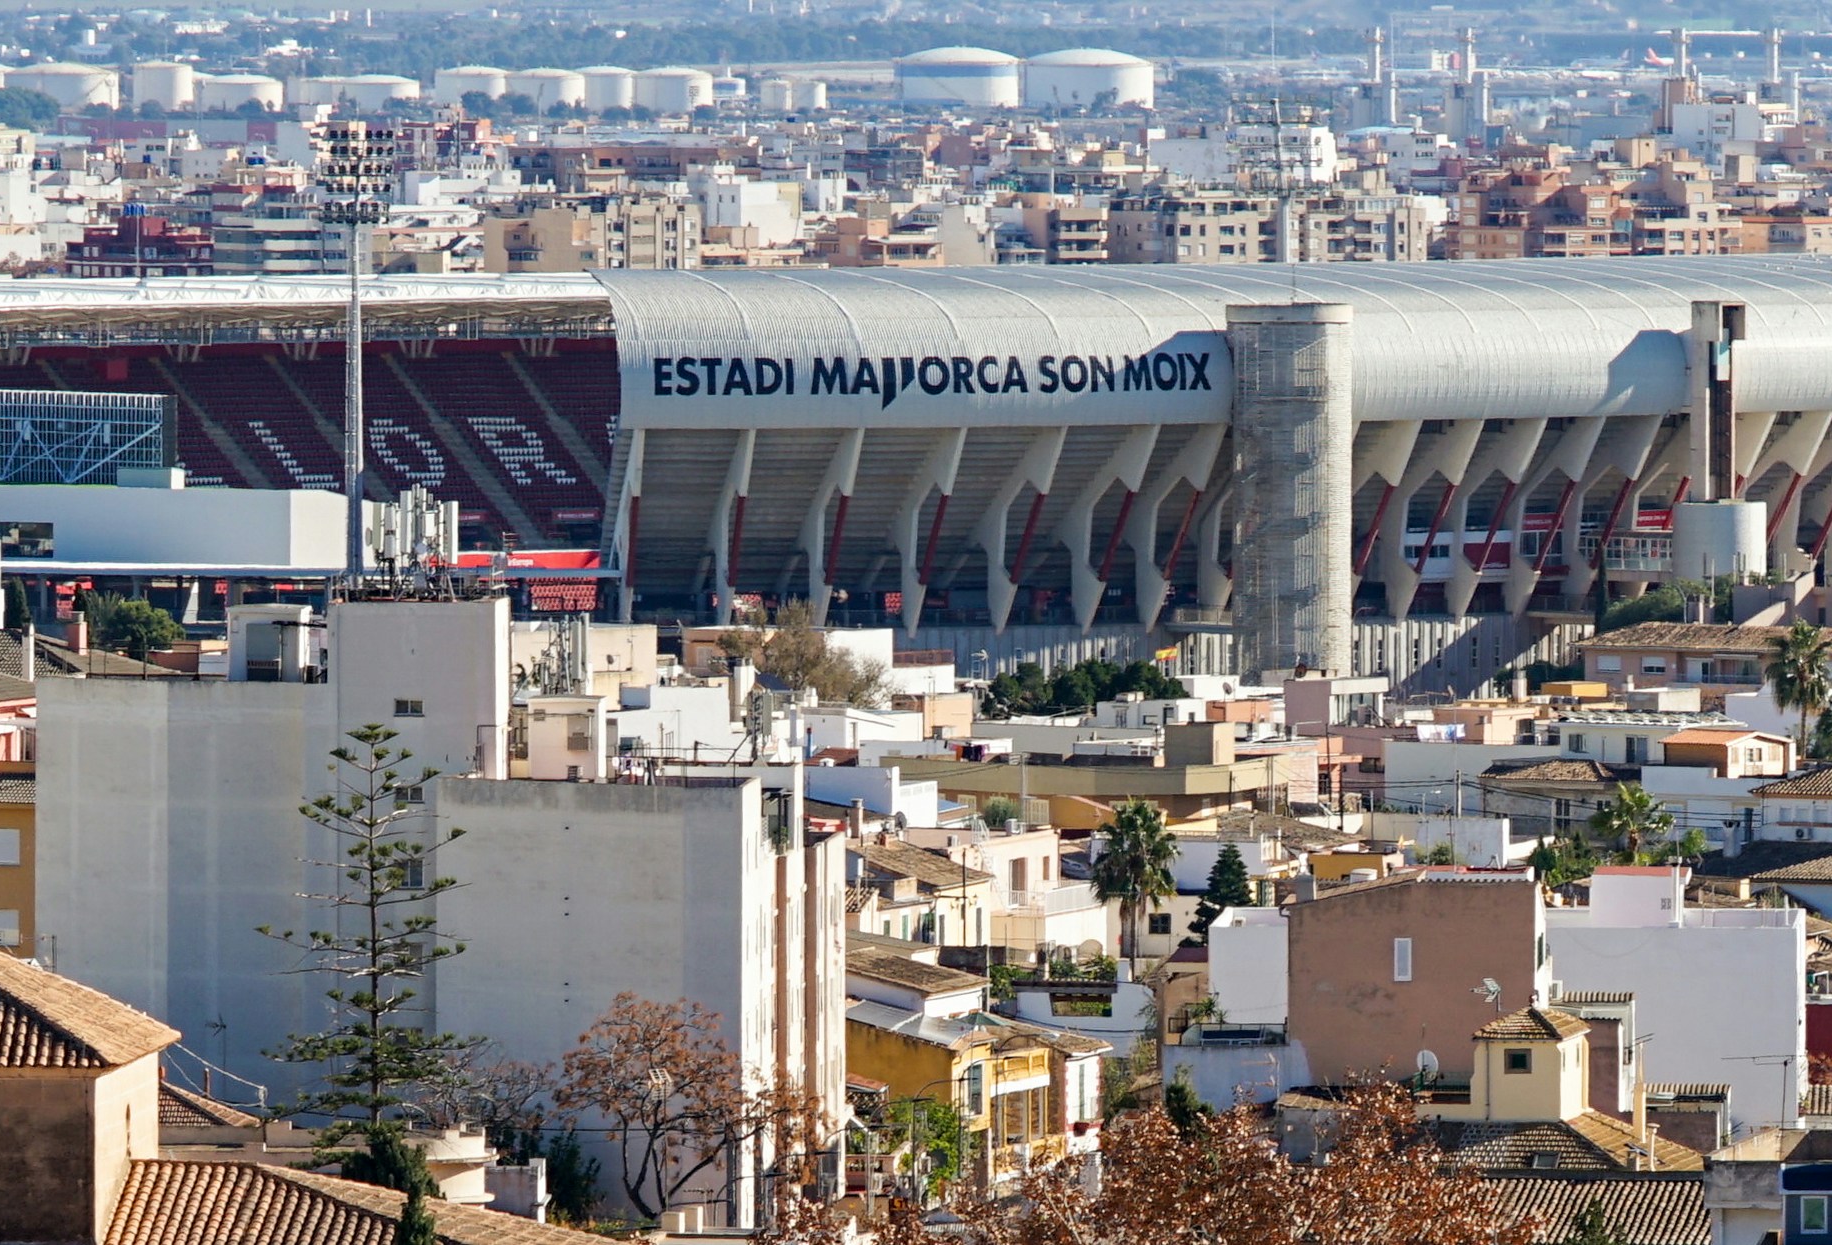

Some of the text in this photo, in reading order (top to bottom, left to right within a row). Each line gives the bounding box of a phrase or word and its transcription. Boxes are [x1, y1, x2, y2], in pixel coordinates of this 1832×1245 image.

[654, 352, 1212, 410] ESTADI MALLORCA SON MOIX
